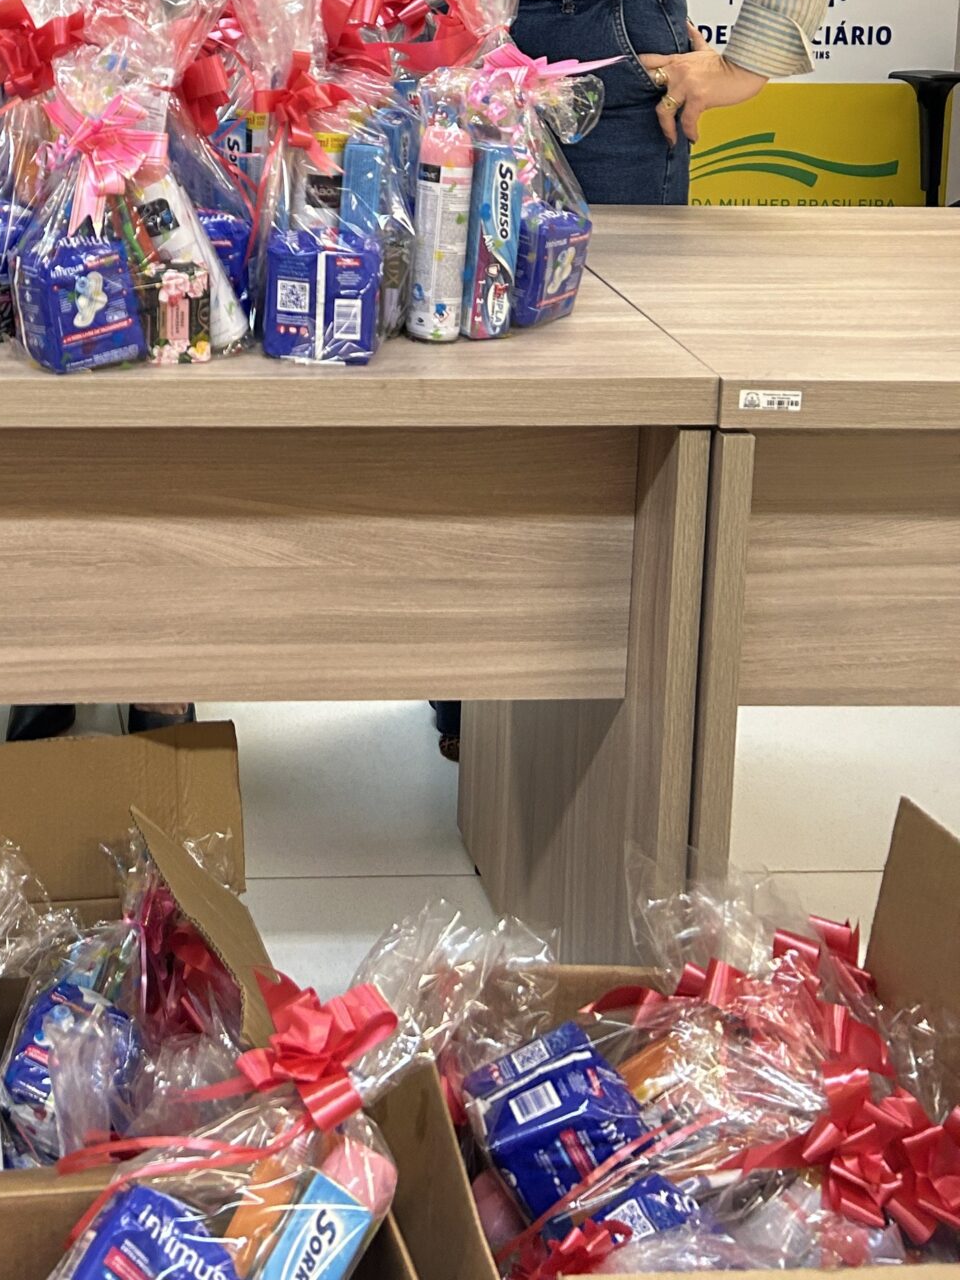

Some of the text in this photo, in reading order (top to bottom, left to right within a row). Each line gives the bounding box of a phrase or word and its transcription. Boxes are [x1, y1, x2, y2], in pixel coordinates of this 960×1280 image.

[498, 163, 514, 240] SORRISO
[137, 1204, 228, 1280] Intimus
[295, 1209, 336, 1280] SORR
